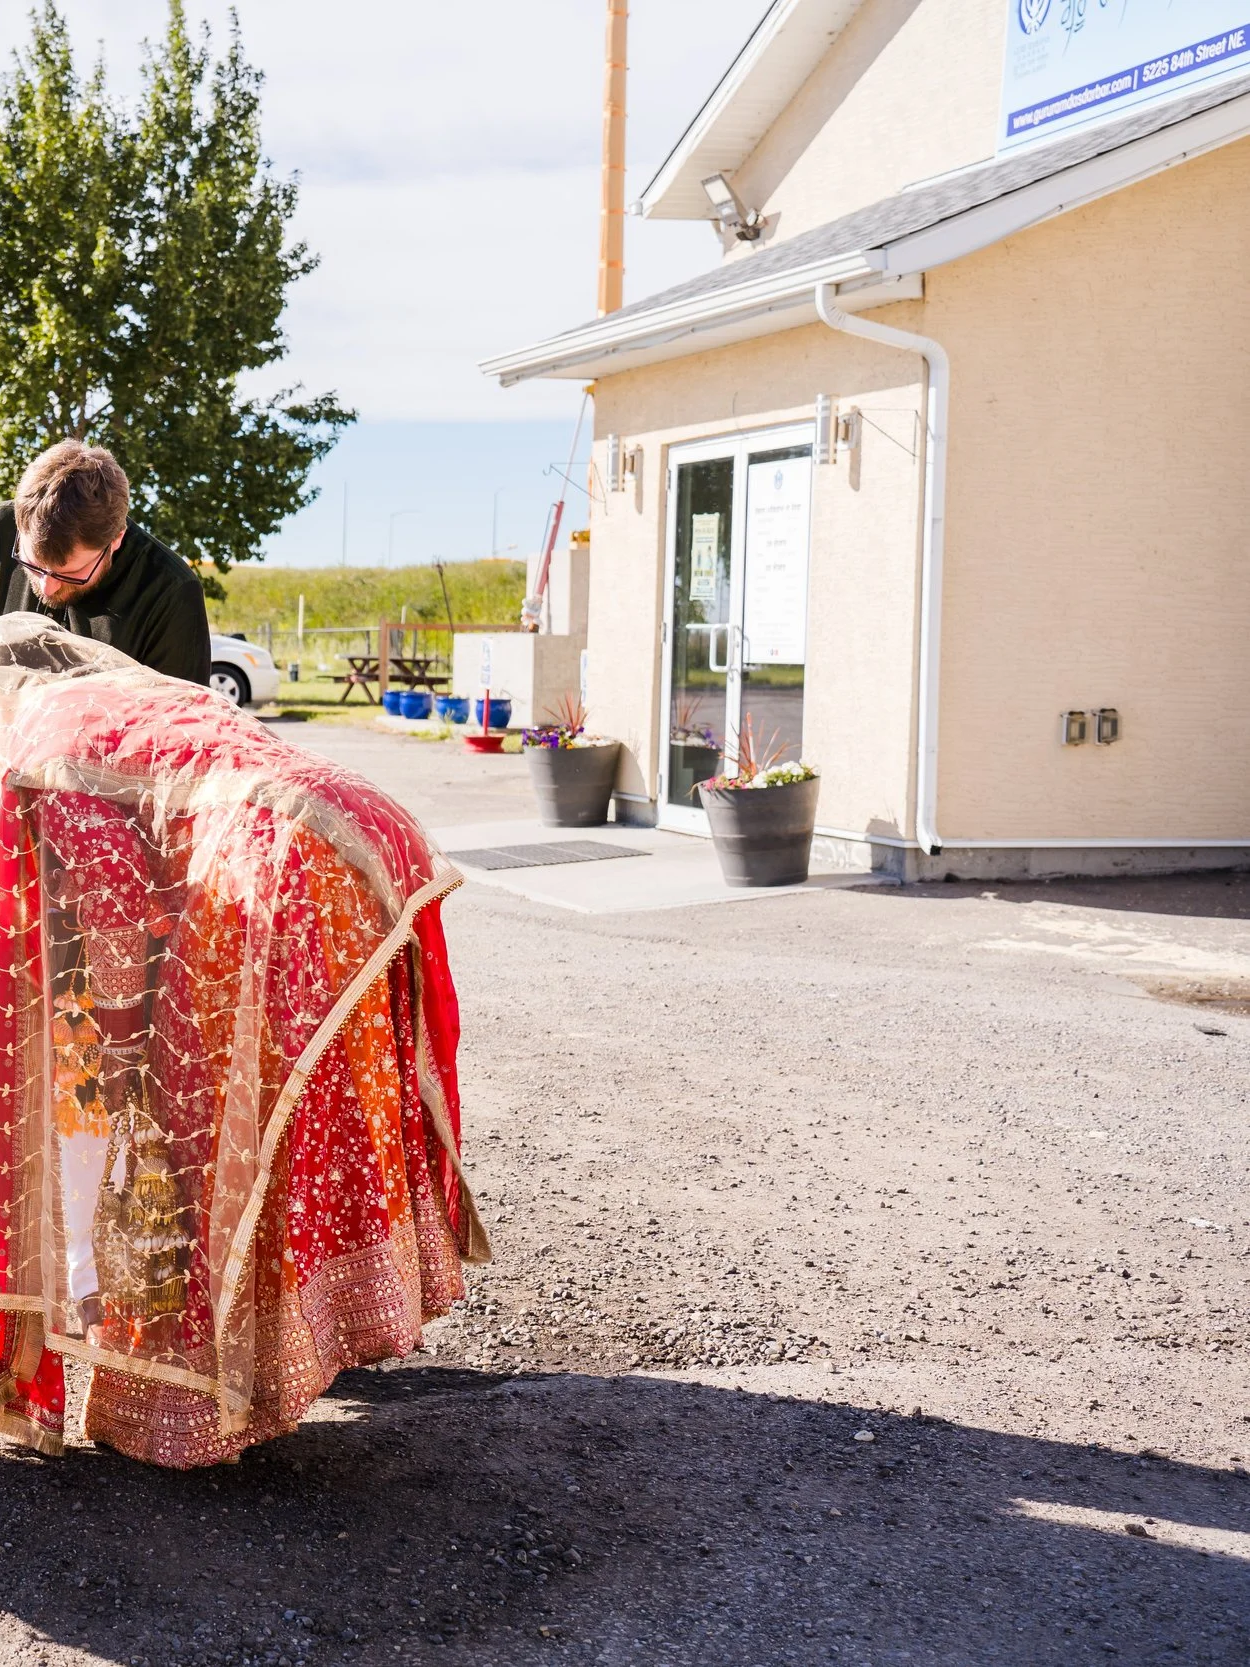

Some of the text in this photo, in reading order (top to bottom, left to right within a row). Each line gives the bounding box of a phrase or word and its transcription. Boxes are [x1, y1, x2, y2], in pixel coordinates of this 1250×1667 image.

[1142, 58, 1170, 82] 5225
[1170, 49, 1194, 72] 84th
[1195, 37, 1227, 62] Street
